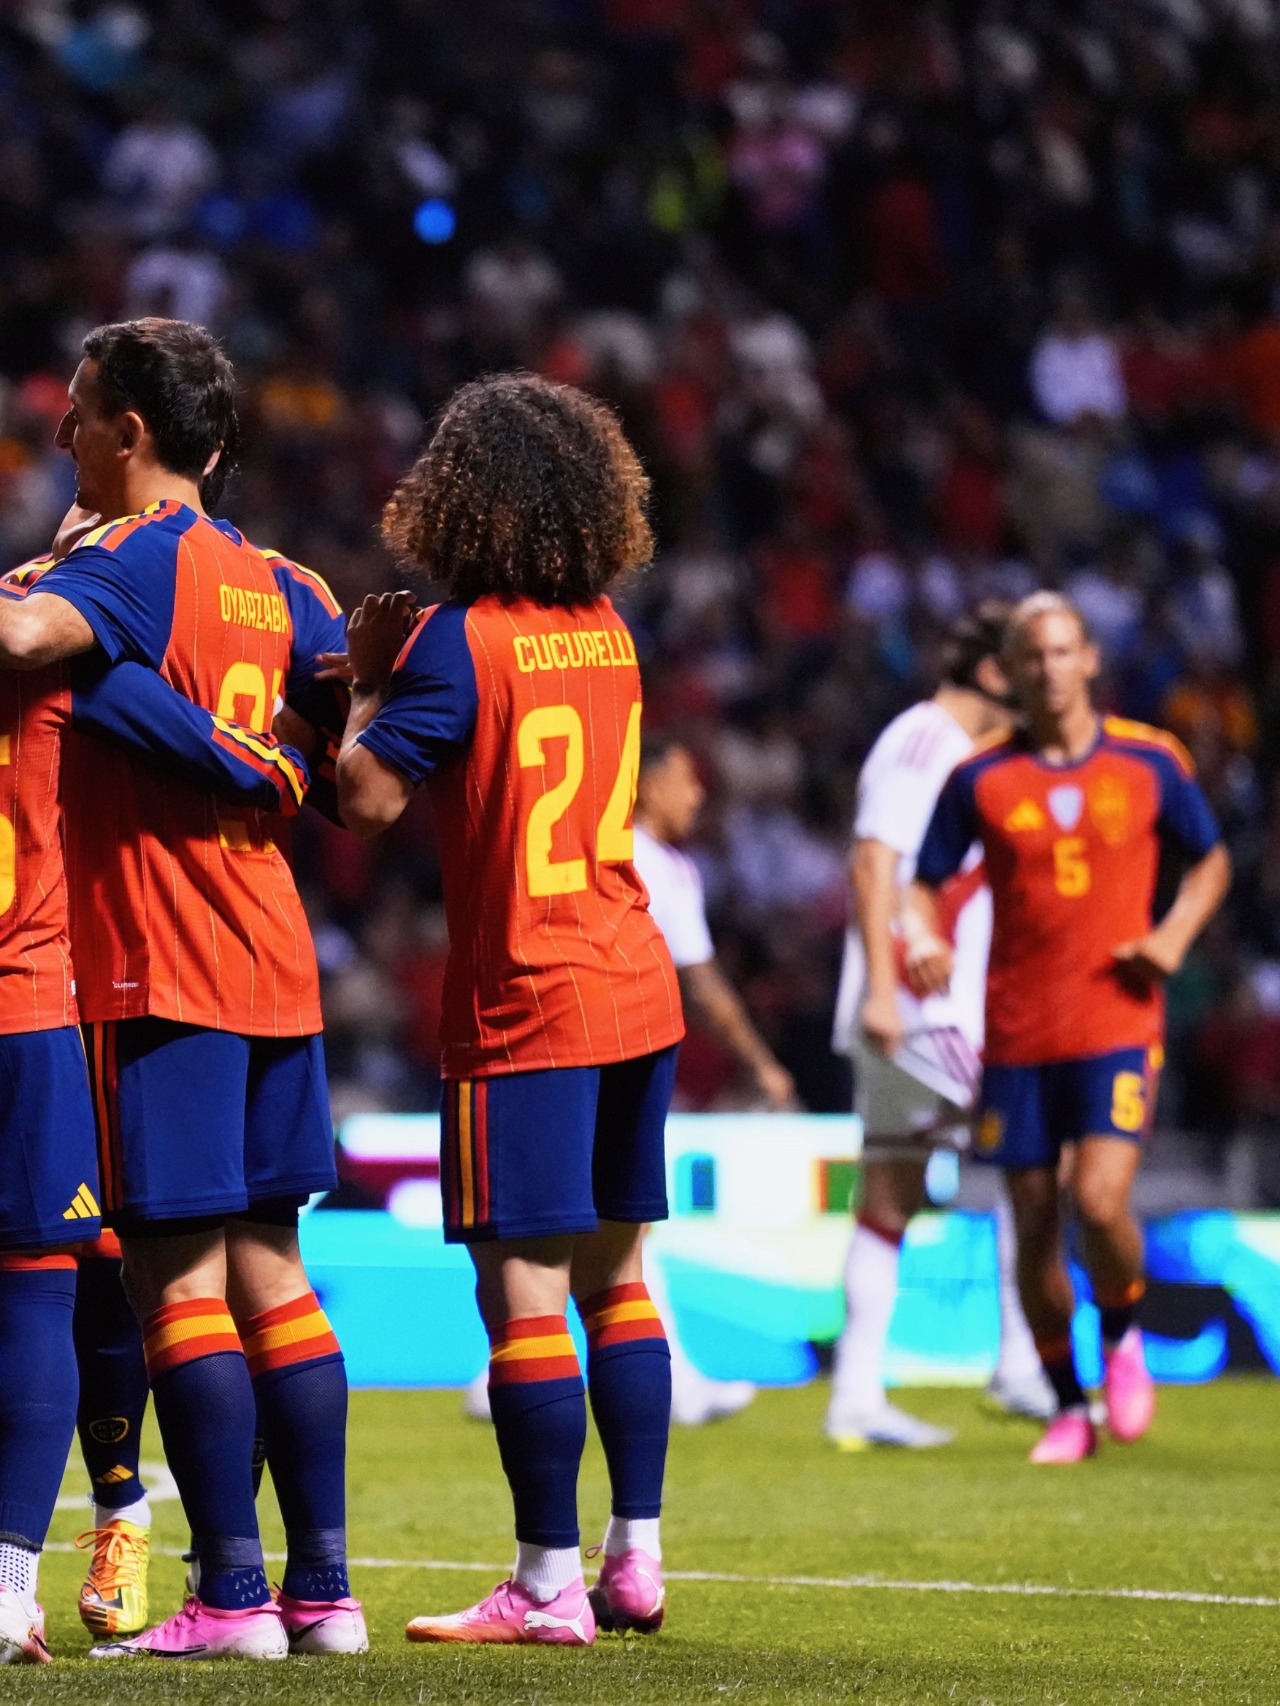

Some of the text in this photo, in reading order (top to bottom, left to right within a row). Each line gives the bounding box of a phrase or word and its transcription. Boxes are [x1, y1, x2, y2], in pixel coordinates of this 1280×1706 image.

[513, 630, 638, 673] CUCURELL
[517, 702, 642, 897] 24
[1053, 836, 1091, 897] 5
